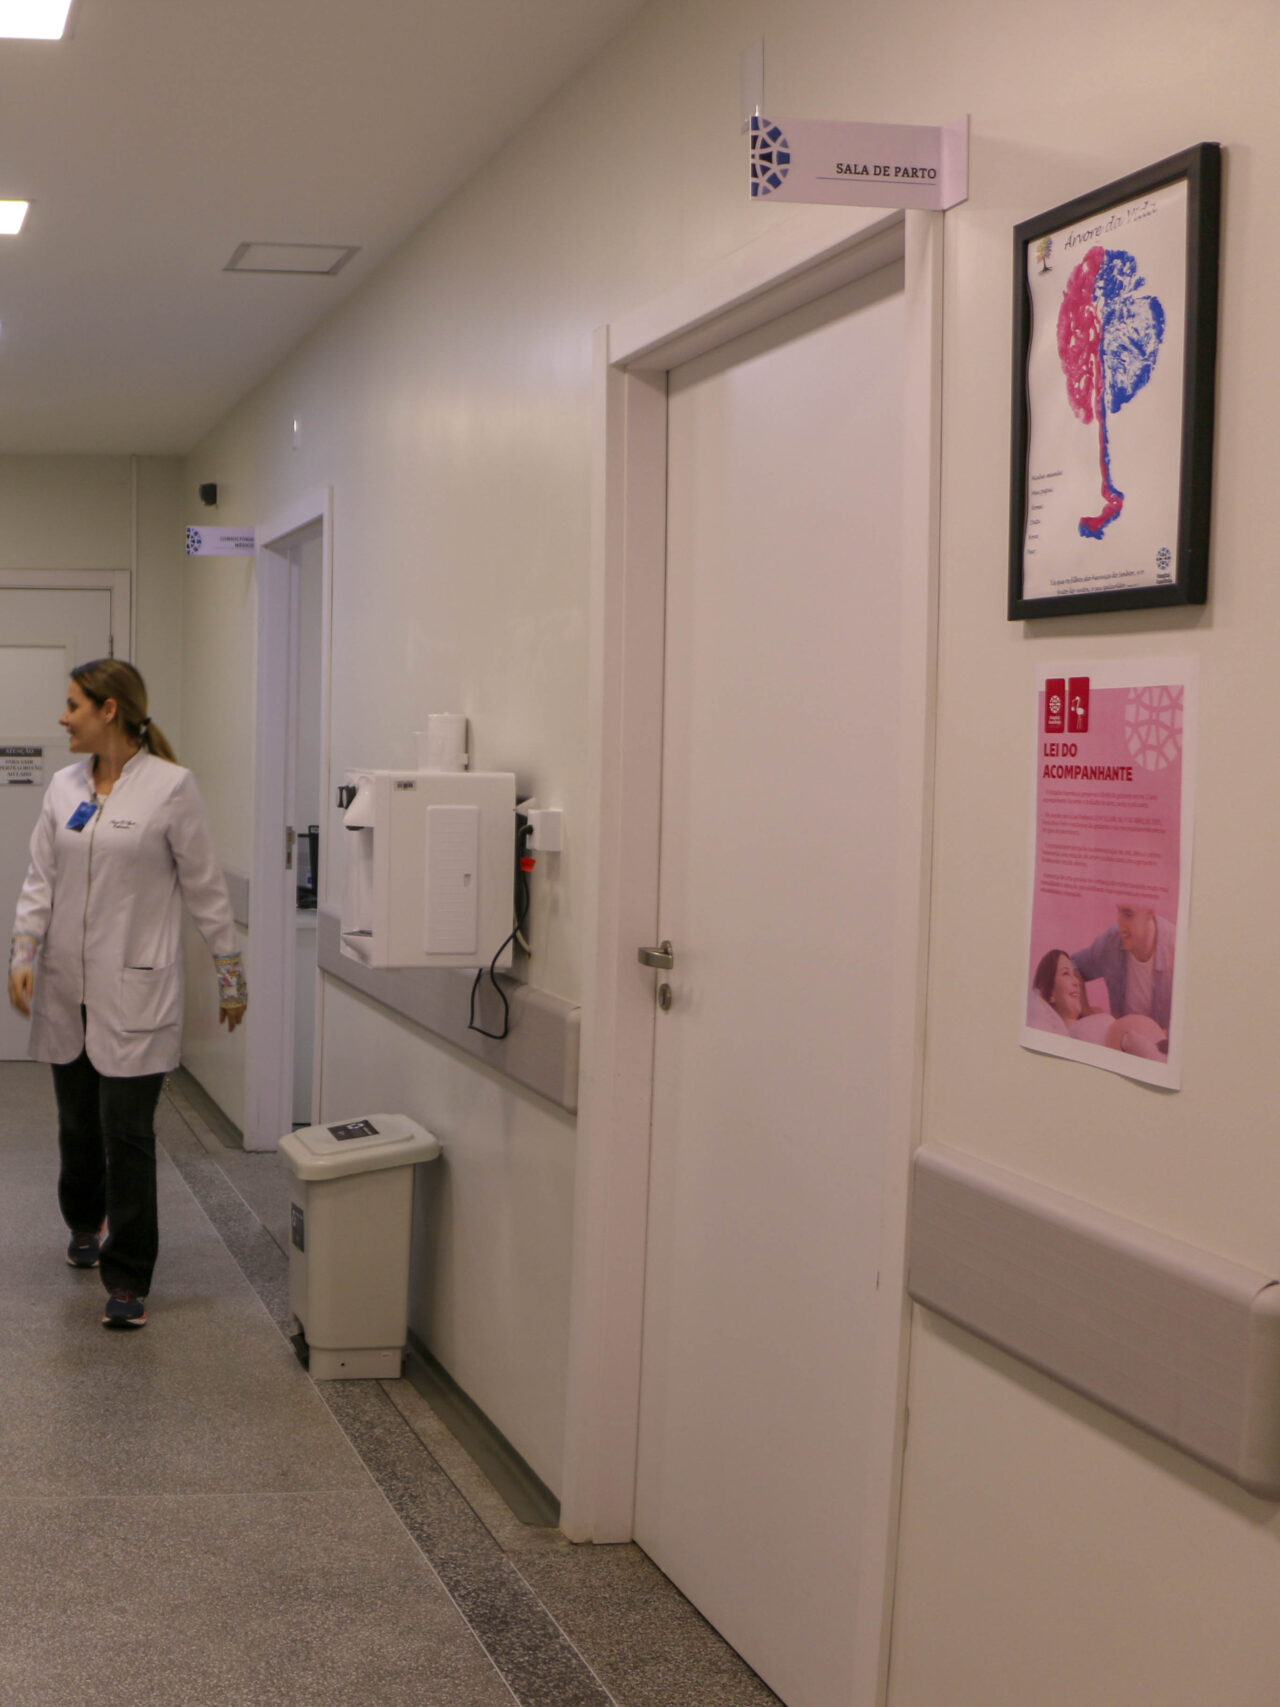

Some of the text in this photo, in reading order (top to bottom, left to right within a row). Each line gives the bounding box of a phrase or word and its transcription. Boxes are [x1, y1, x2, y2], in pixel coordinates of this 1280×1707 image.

[836, 162, 937, 179] SALA DE PARTO
[1105, 215, 1122, 233] da
[1043, 742, 1078, 758] LEI DO
[1042, 764, 1133, 782] ACOMPANHANTE
